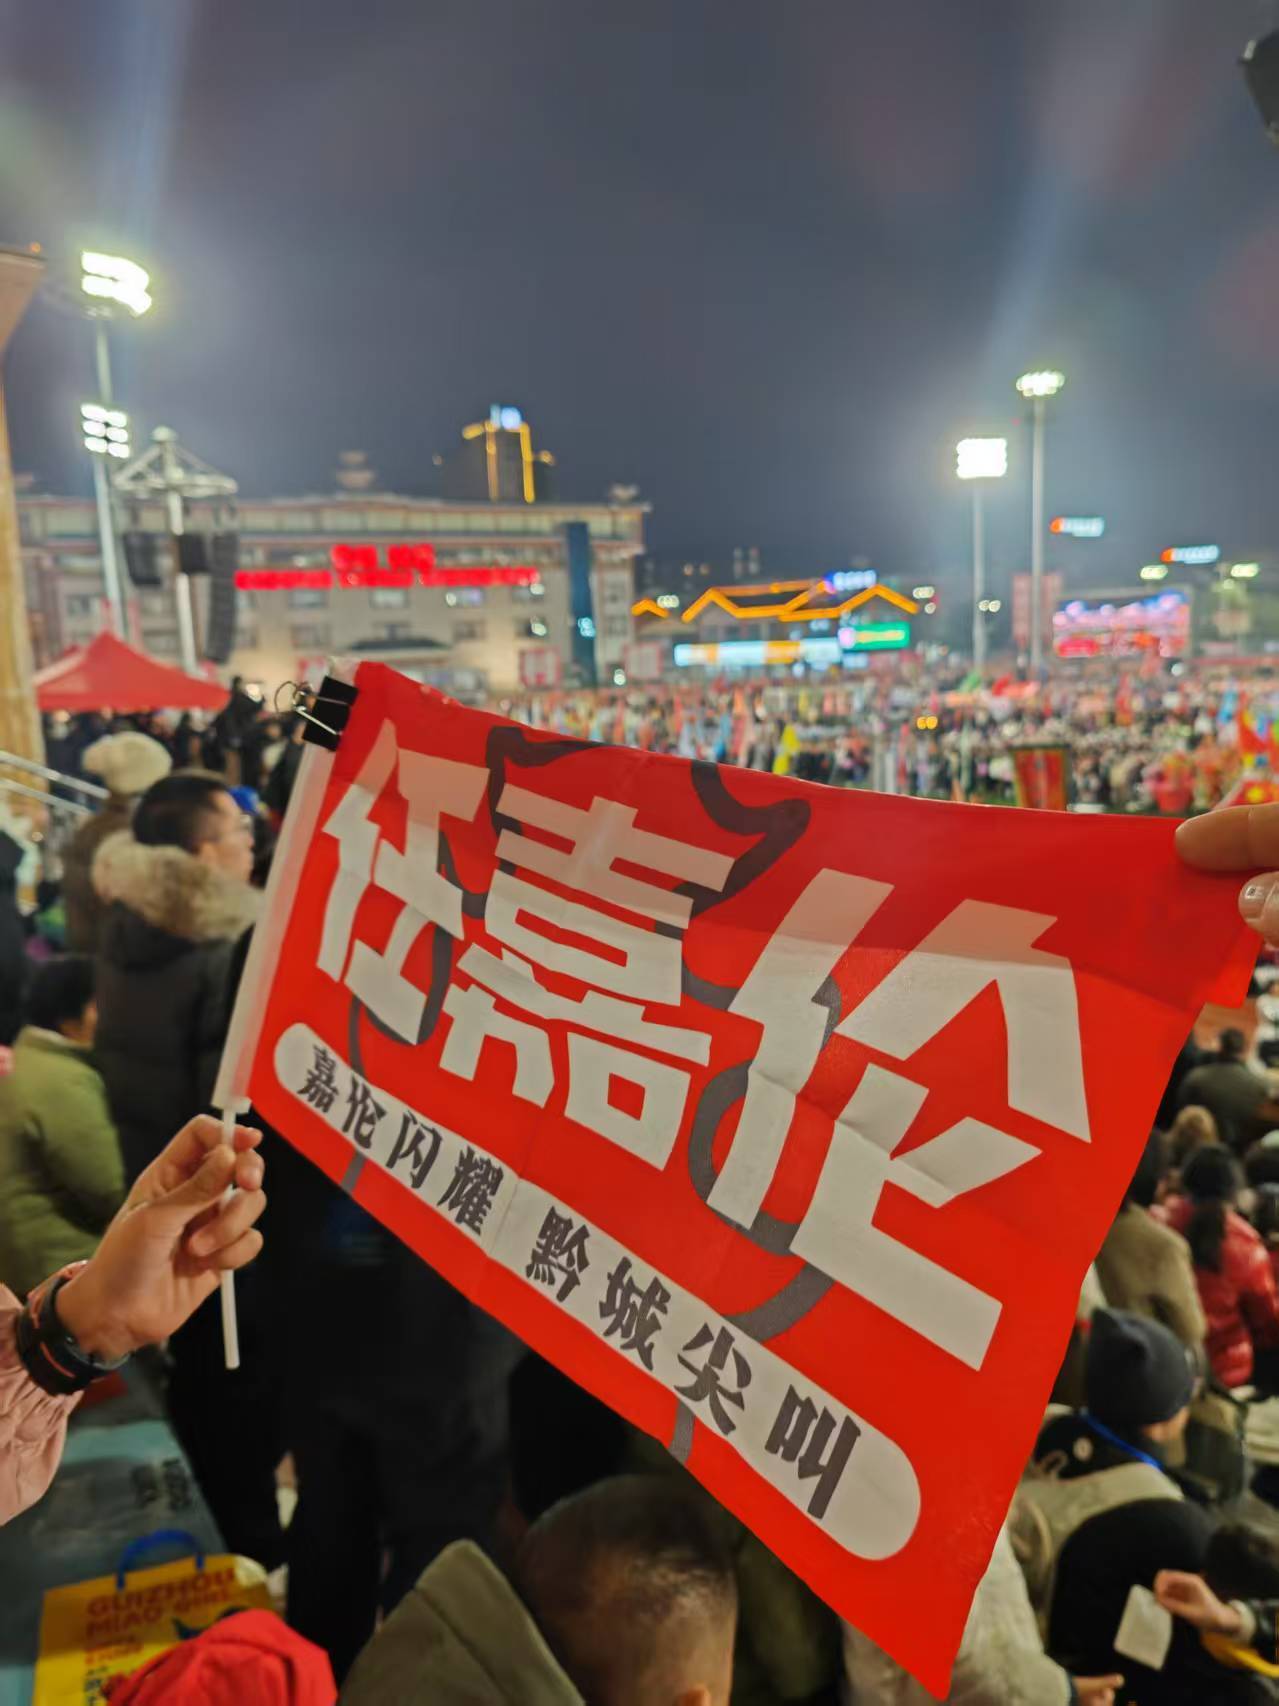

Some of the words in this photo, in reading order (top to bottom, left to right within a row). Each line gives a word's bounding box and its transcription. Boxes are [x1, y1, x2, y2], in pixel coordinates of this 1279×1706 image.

[297, 1044, 504, 1235] 嘉伦闪耀
[525, 1206, 861, 1520] 黔城尖叫
[315, 723, 1091, 1371] 任嘉伦
